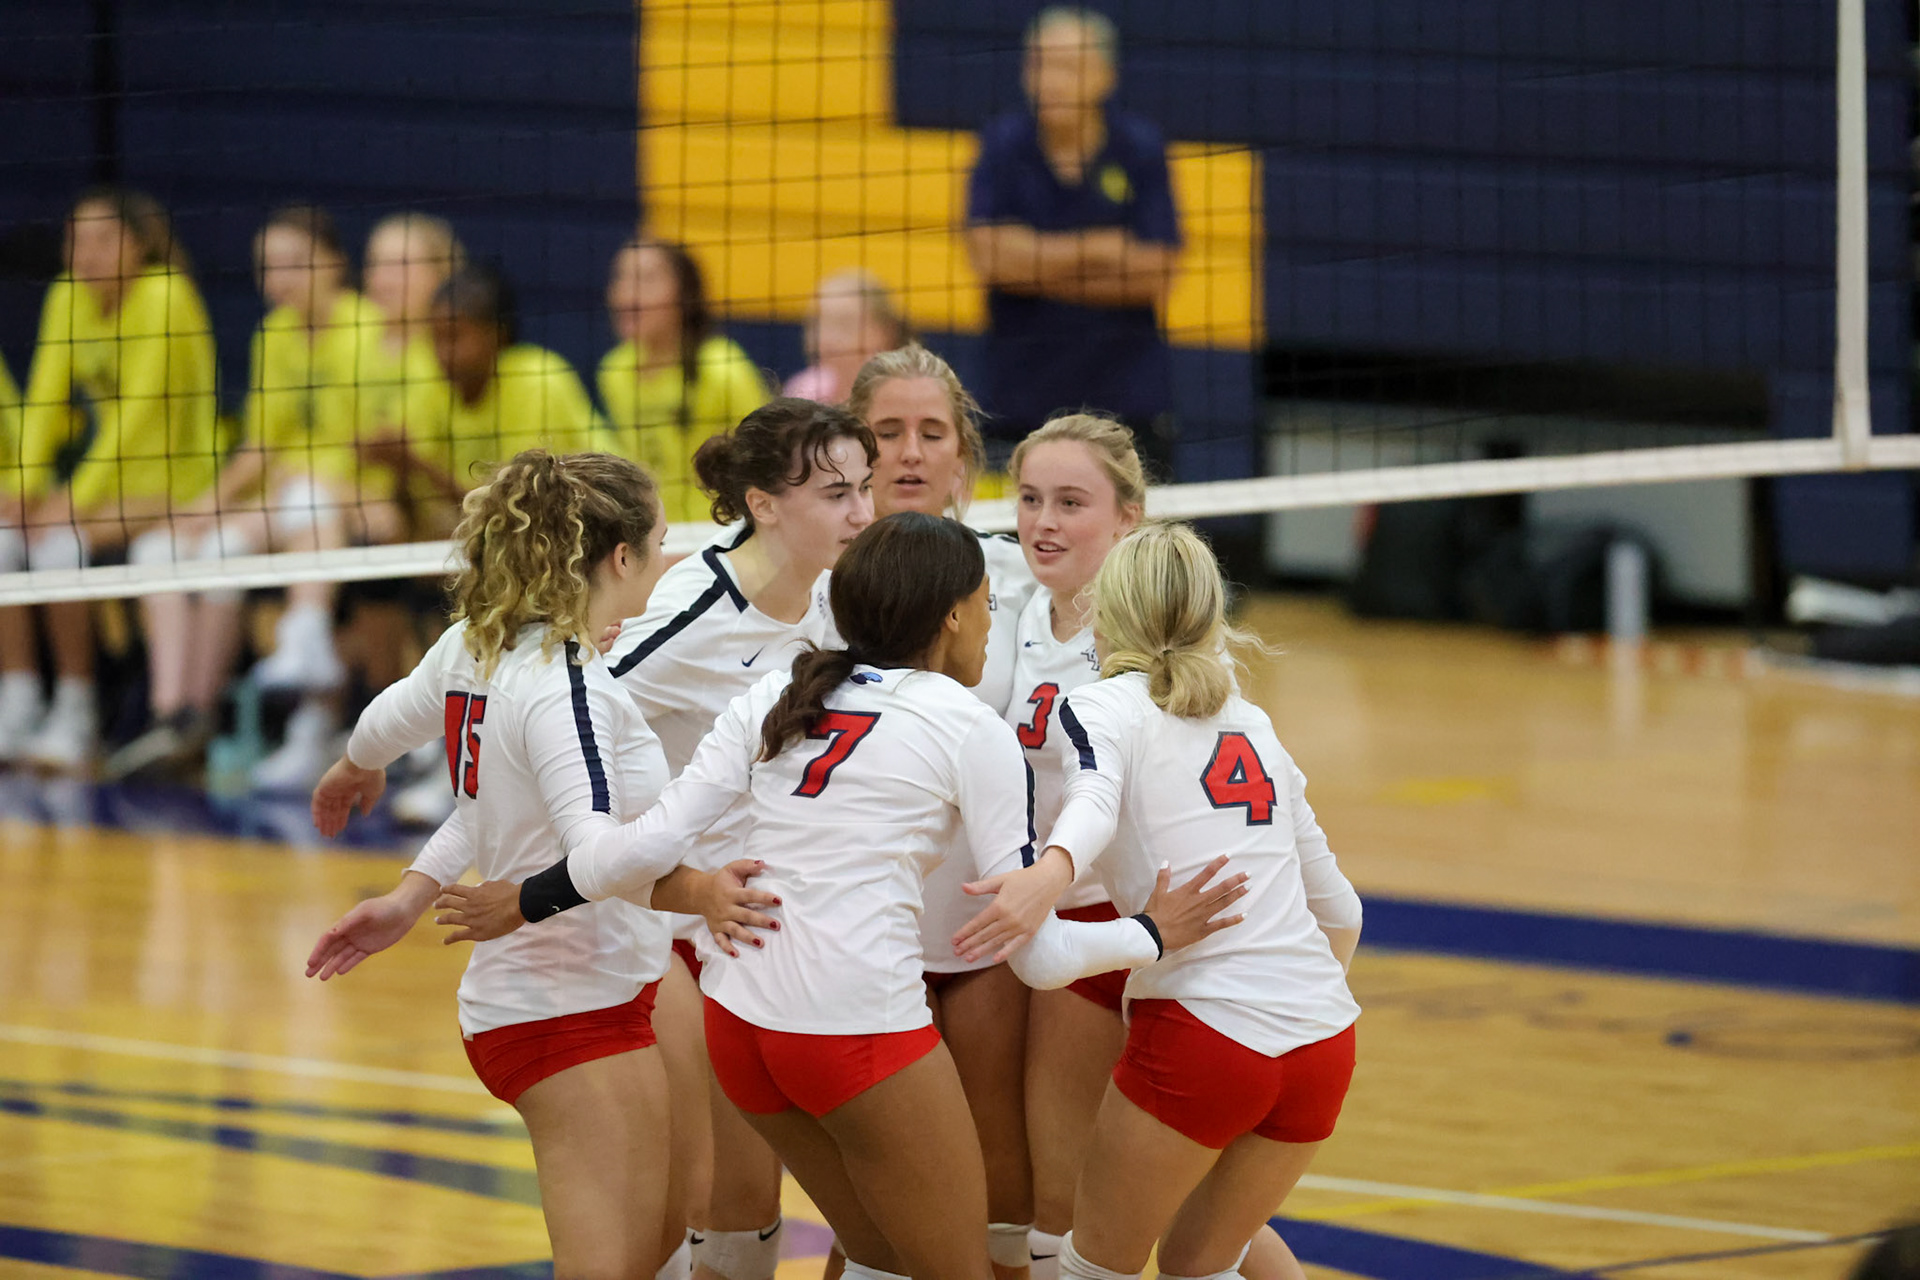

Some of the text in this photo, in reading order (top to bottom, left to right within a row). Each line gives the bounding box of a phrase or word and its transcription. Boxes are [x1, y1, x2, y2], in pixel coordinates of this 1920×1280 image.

[790, 710, 882, 798] 7
[1017, 682, 1059, 749] 3
[1200, 731, 1278, 826] 4
